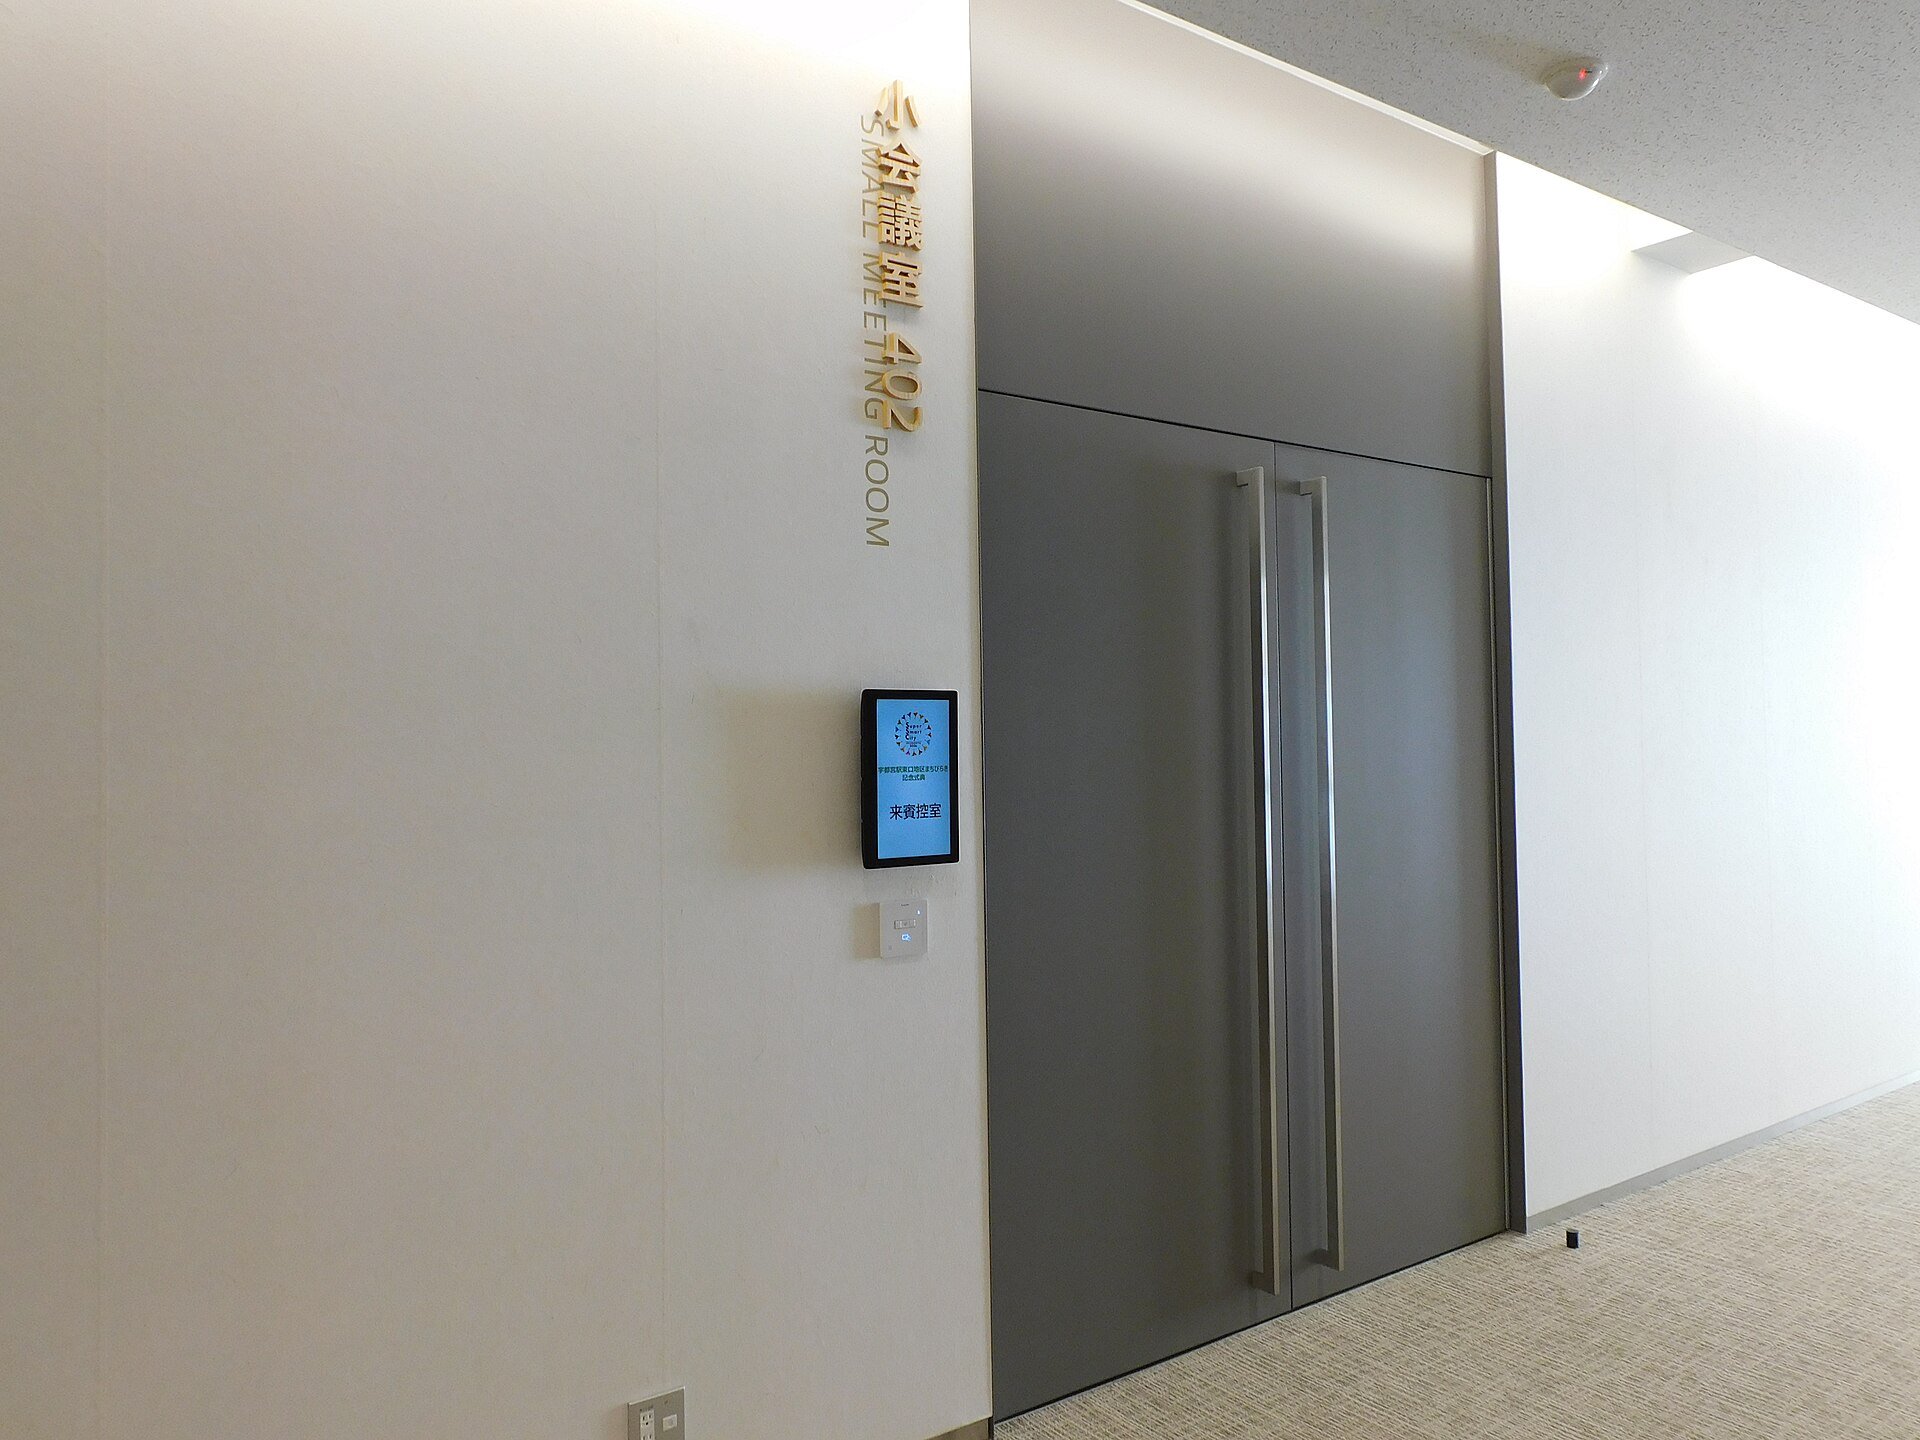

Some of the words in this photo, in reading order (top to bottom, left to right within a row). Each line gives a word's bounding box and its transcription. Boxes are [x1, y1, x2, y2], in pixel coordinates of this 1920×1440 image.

[861, 114, 885, 238] SMALL
[875, 80, 924, 308] 小会議室
[863, 252, 888, 420] MEETING
[882, 332, 923, 432] 402
[865, 434, 890, 547] ROOM
[889, 803, 942, 820] 来賓控室
